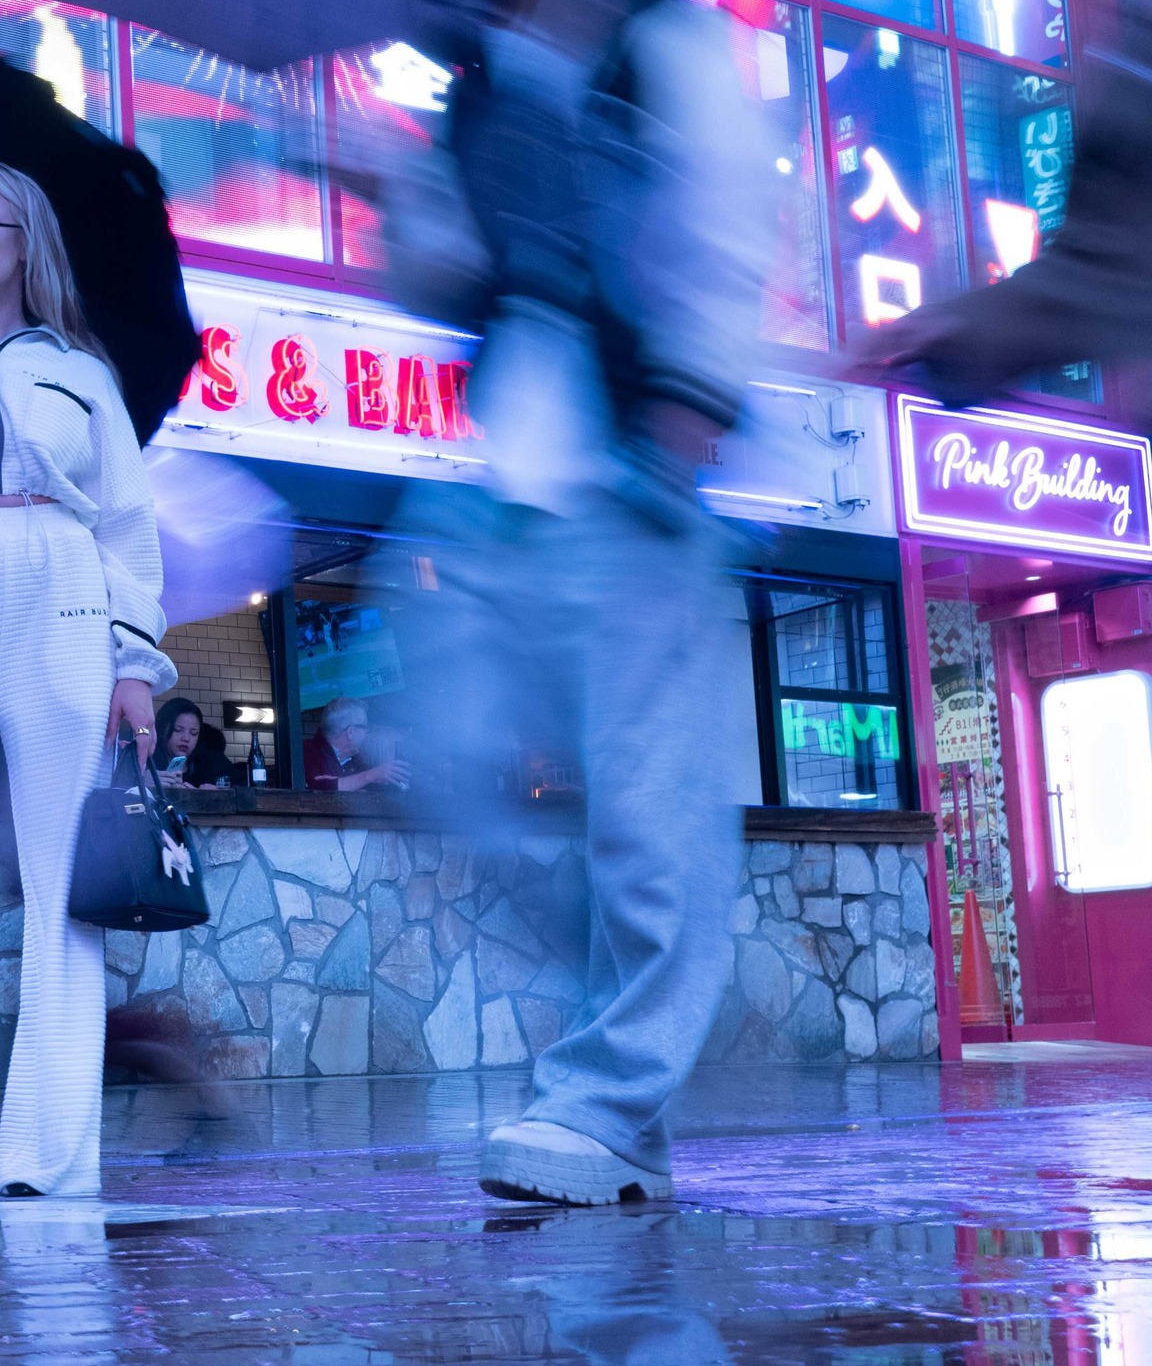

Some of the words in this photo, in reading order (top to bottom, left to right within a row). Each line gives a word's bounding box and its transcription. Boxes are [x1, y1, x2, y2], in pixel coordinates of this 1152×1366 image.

[851, 146, 923, 329] 入口
[268, 333, 332, 424] &
[934, 432, 1010, 490] Pink
[1011, 446, 1132, 537] Building
